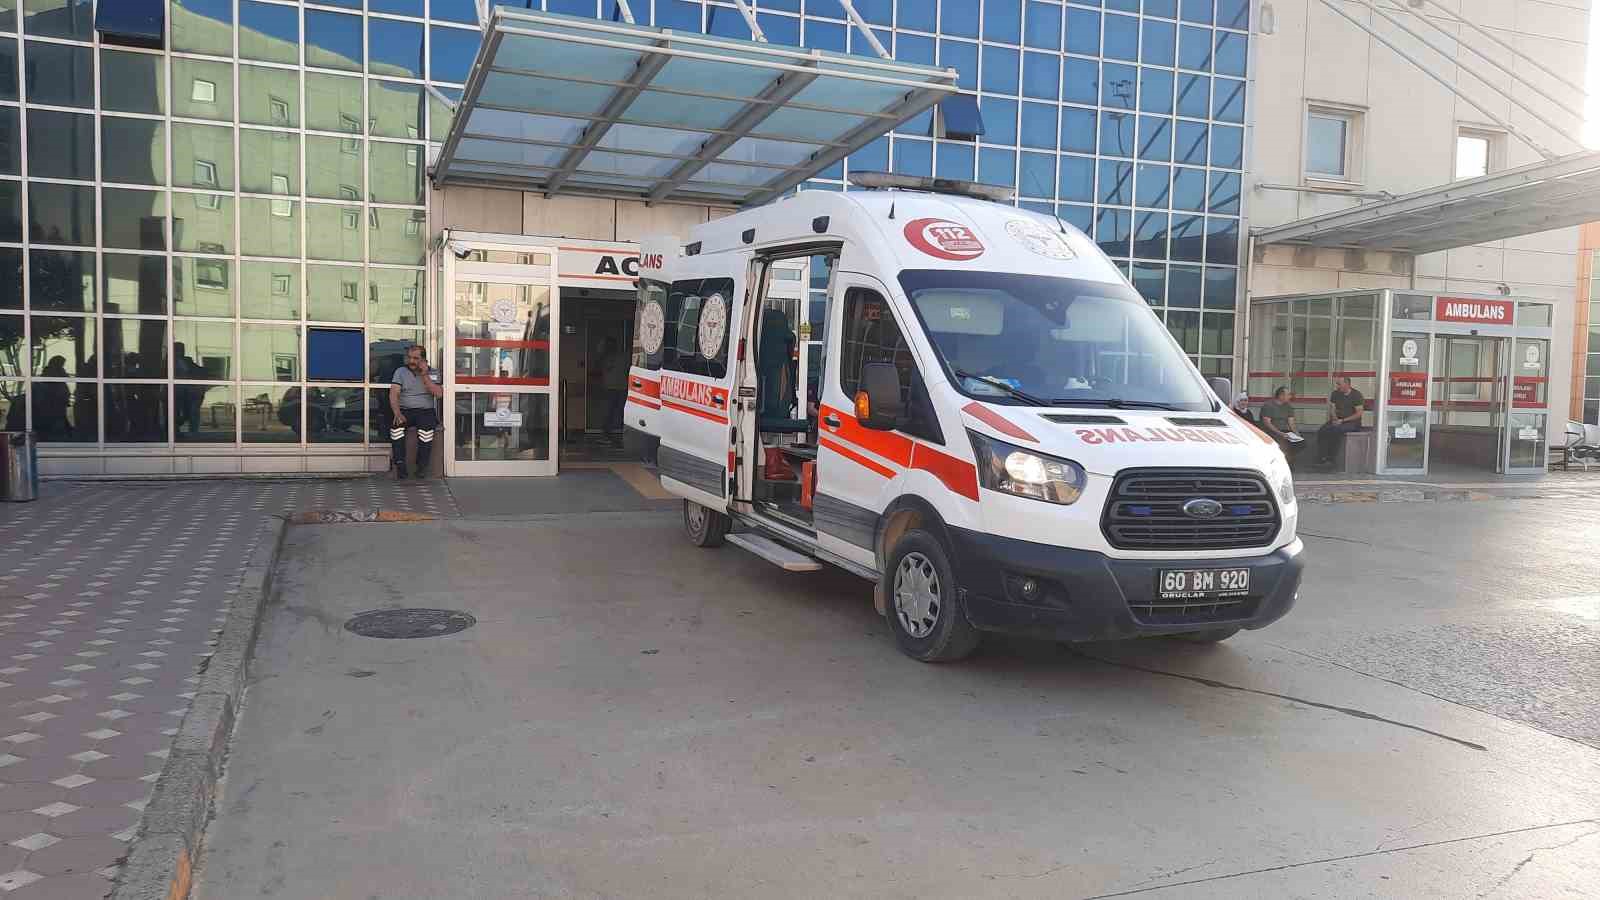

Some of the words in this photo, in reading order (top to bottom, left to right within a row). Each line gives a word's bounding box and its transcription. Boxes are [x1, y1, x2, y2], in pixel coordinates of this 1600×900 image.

[932, 227, 971, 240] 112
[1445, 302, 1505, 319] AMBULANS
[660, 377, 711, 405] AMBULANS
[1165, 572, 1186, 590] 60
[1193, 572, 1214, 590] BM
[1220, 571, 1248, 588] 920
